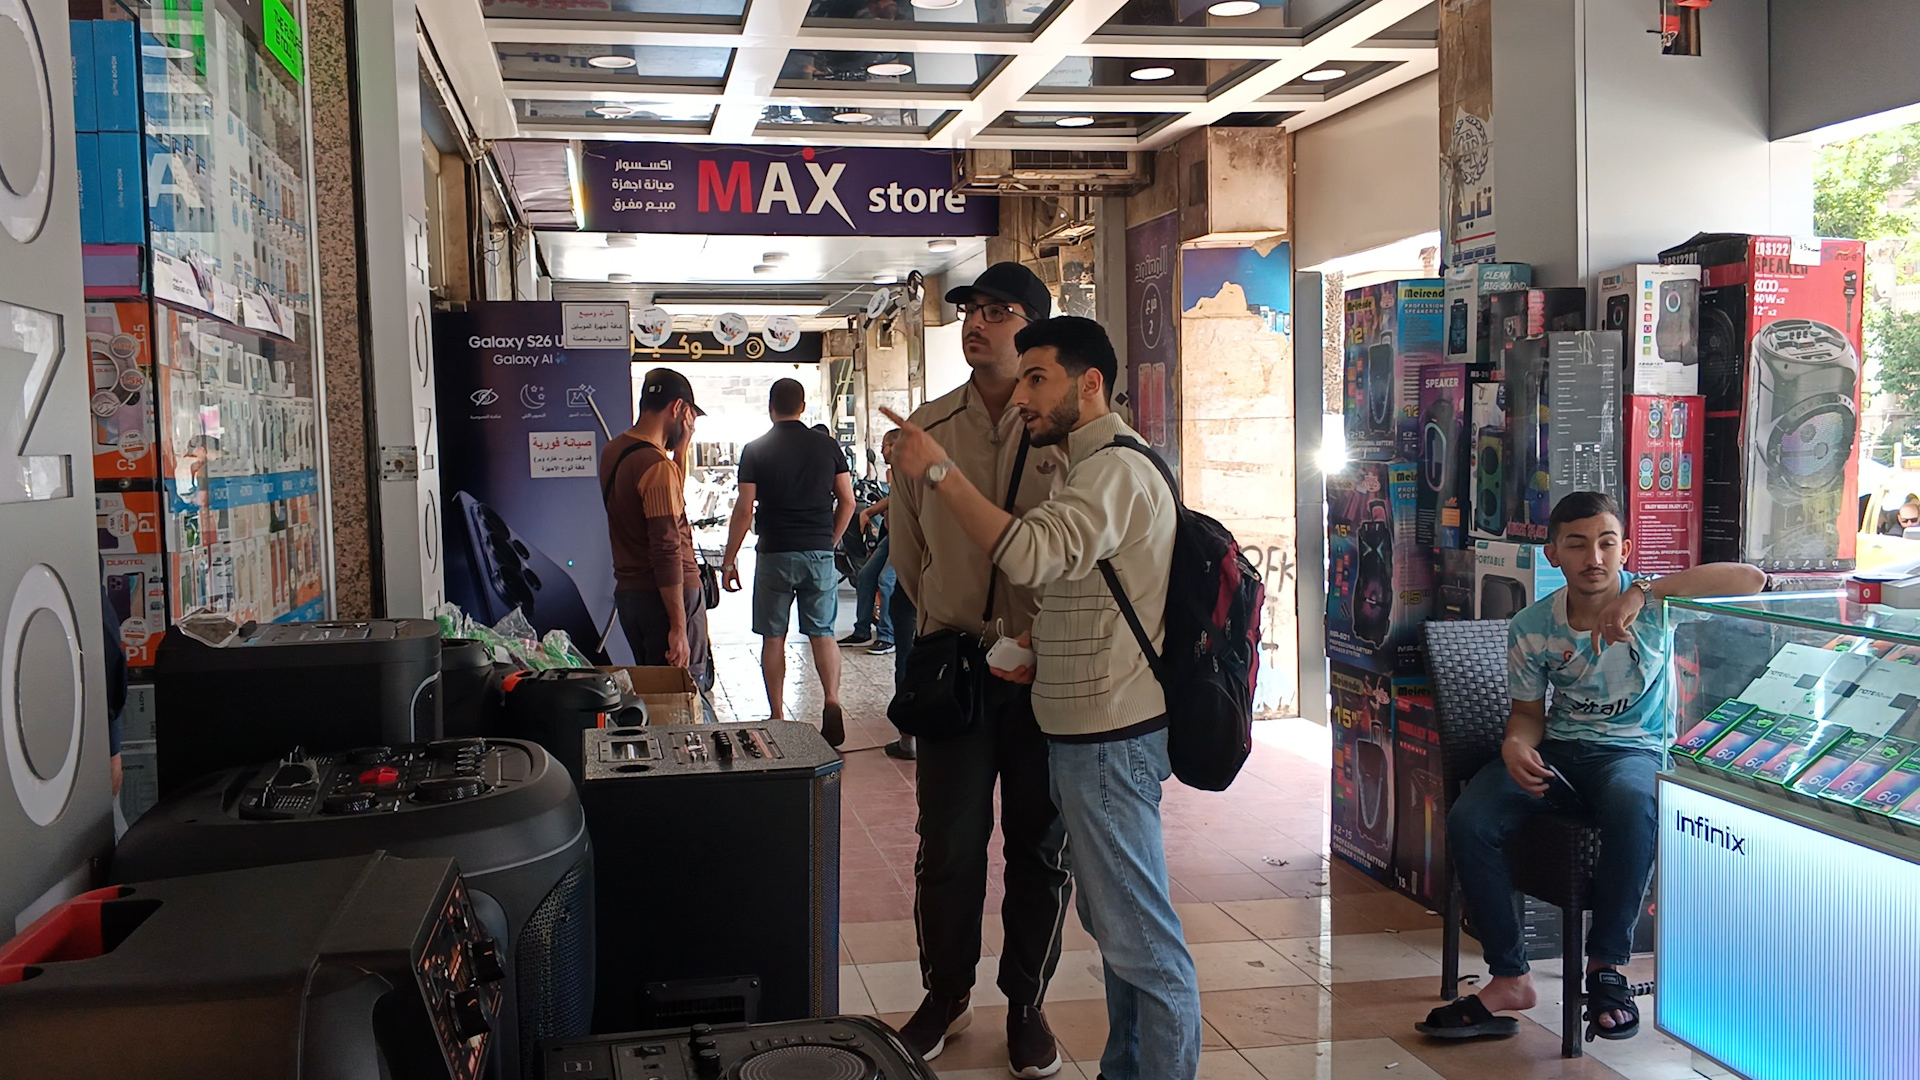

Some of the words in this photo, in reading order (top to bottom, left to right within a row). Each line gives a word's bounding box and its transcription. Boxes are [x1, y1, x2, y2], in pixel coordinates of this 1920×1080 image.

[615, 159, 671, 172] اكسسوار
[612, 178, 641, 192] اجهزة
[644, 179, 674, 191] صيانة
[698, 155, 856, 230] MAX
[868, 182, 966, 213] store
[612, 198, 643, 212] مفرق
[645, 200, 676, 213] مبيع
[1483, 271, 1510, 280] CLEAN
[1483, 282, 1500, 290] BIG
[133, 323, 145, 342] C5
[469, 335, 524, 351] Galaxy
[527, 335, 552, 348] S26
[493, 354, 539, 367] Galaxy
[541, 354, 553, 364] AI
[1425, 378, 1459, 389] SPEAKER
[533, 436, 560, 450] فورية
[563, 436, 592, 450] صيانة
[116, 458, 137, 471] C5
[138, 512, 156, 534] P1
[1475, 553, 1505, 567] PORTABLE
[125, 646, 148, 661] P1
[1334, 706, 1357, 729] 15"
[1687, 737, 1706, 748] 60
[1716, 748, 1736, 760] 60
[1745, 757, 1766, 769] 60
[1808, 774, 1830, 787] 60
[1841, 780, 1864, 793] 60
[1876, 791, 1901, 804] 60
[1676, 809, 1745, 856] Infinix
